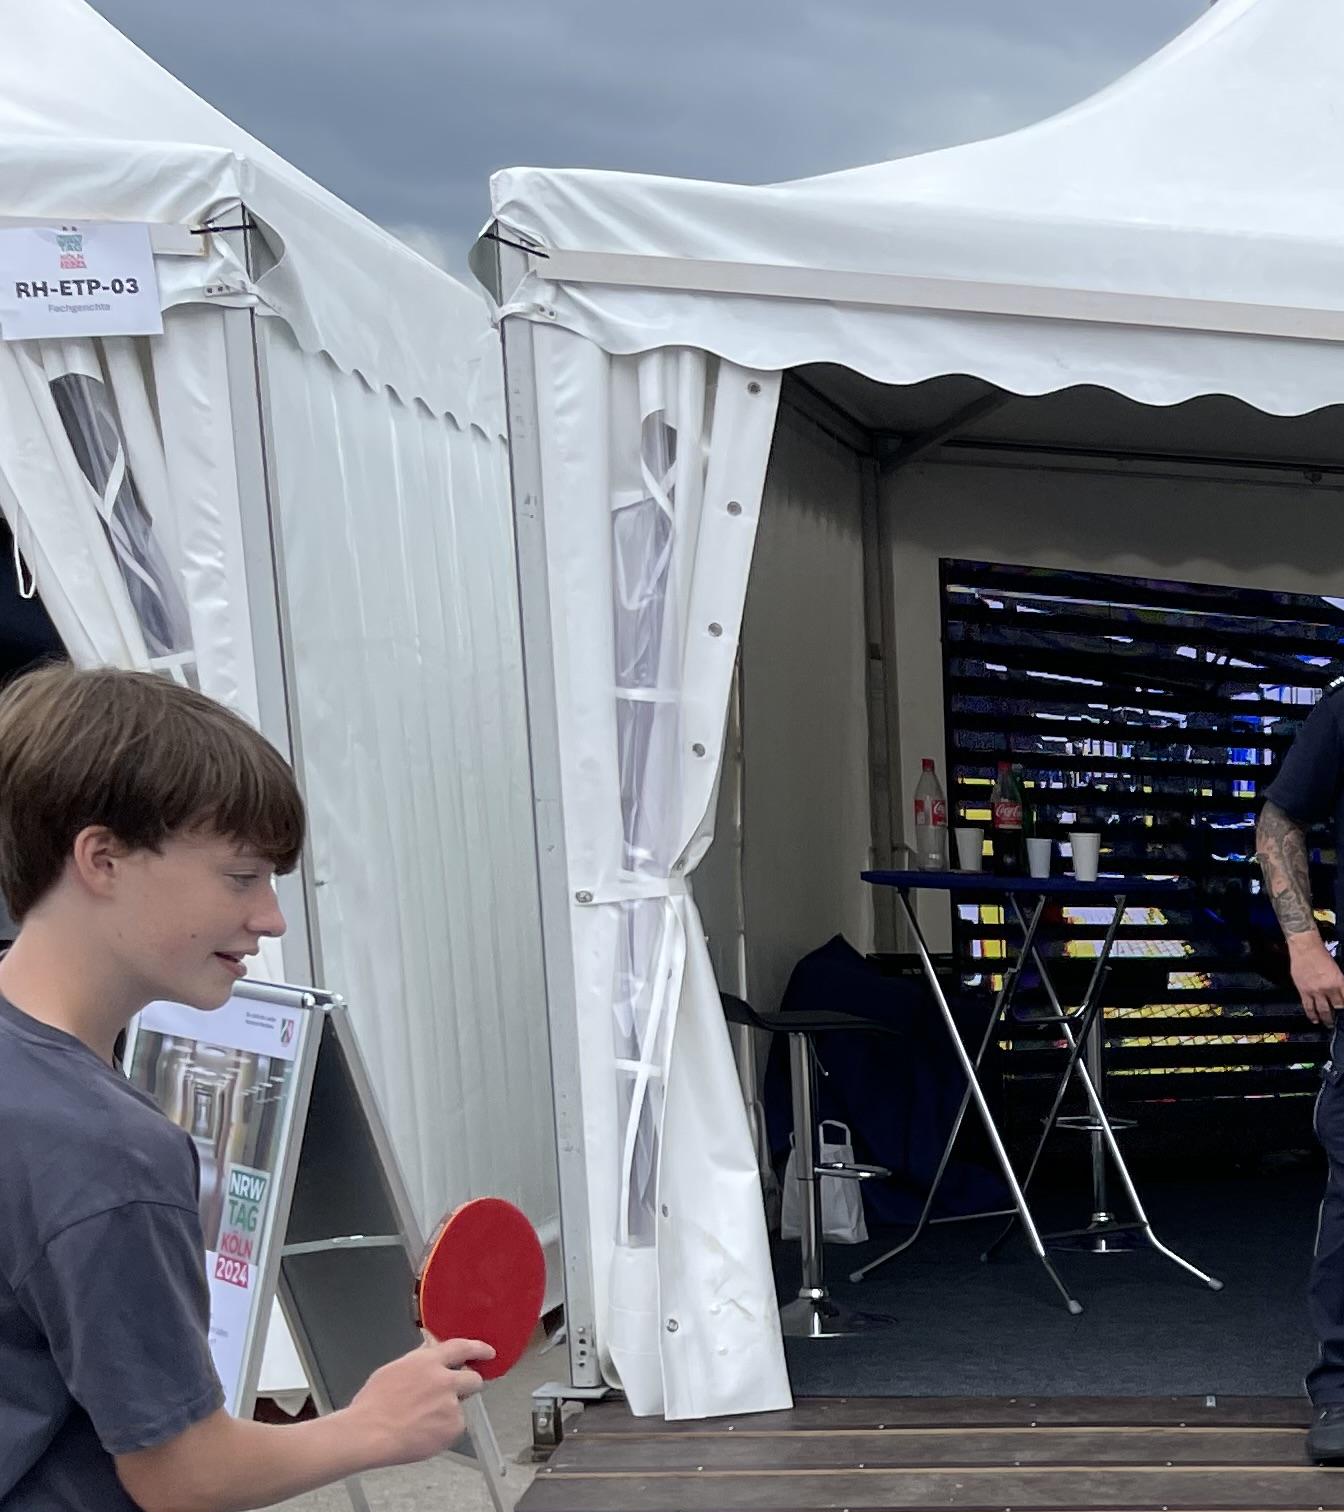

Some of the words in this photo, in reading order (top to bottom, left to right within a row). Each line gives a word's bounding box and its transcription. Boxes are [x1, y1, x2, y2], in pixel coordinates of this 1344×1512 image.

[15, 278, 139, 299] RH-ETP-03
[230, 1171, 266, 1201] NRW
[228, 1199, 260, 1232] TAG
[220, 1231, 254, 1259] KÖLN
[216, 1257, 248, 1287] 2024
